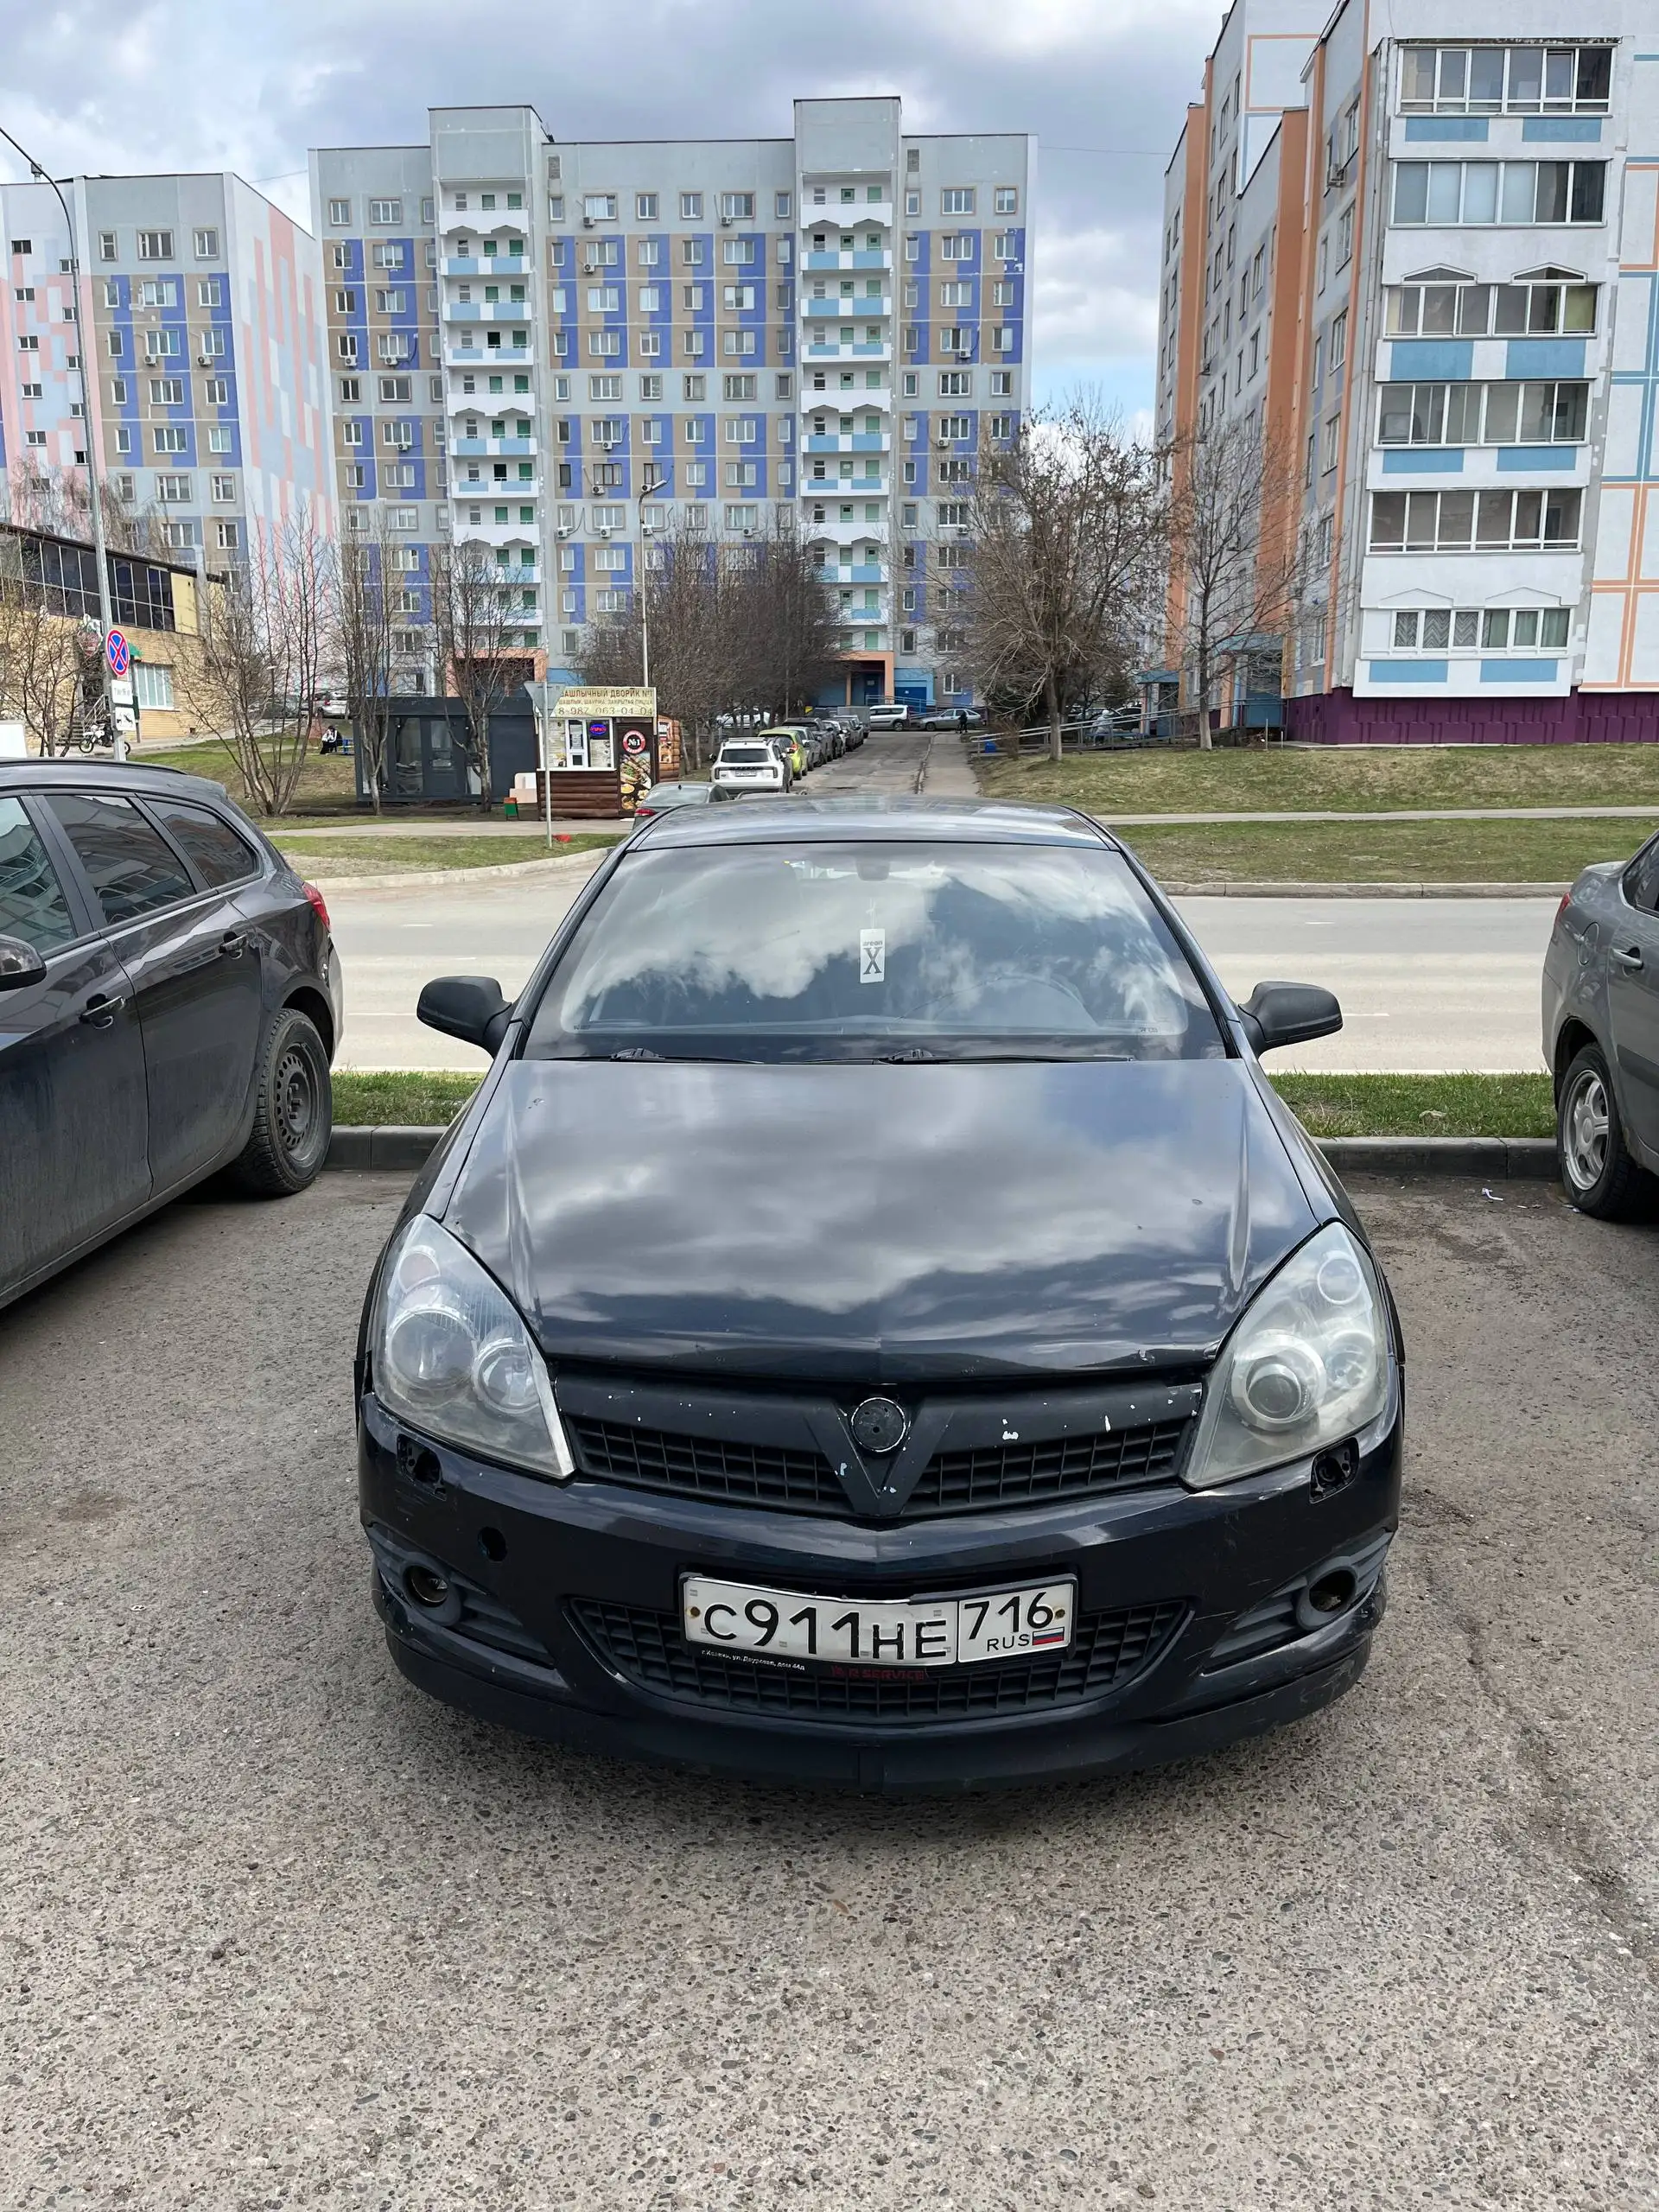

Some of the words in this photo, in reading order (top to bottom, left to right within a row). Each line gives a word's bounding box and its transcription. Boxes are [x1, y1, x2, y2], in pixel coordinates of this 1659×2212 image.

[863, 947, 882, 975] X
[963, 1592, 1053, 1640] 716
[986, 1634, 1030, 1653] RUS
